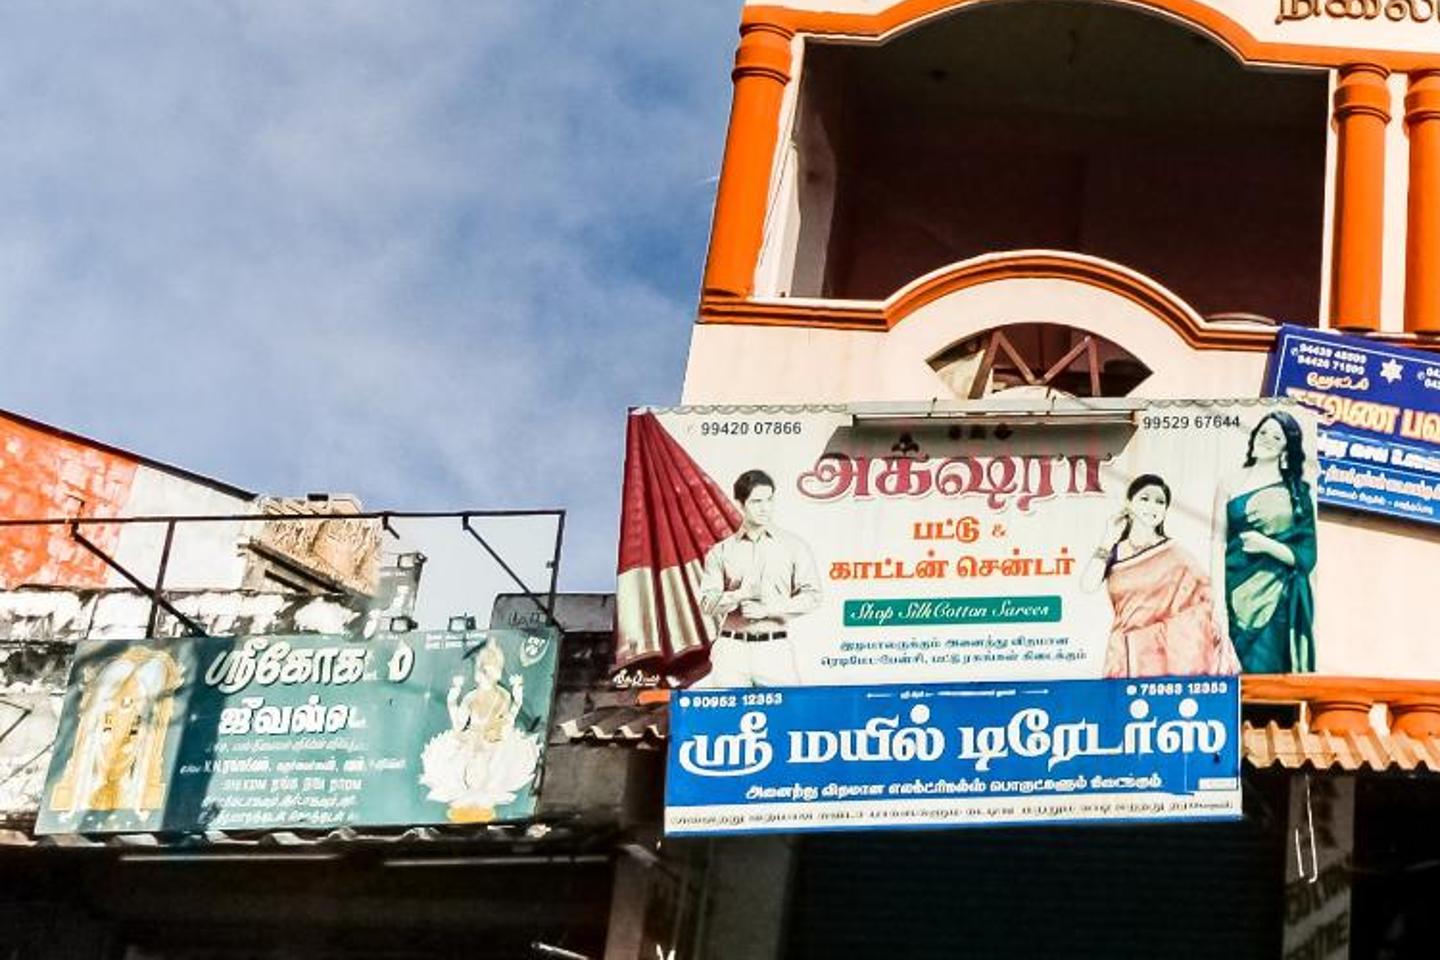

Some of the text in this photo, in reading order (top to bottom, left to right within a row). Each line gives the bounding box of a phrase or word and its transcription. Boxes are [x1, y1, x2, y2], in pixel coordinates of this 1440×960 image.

[701, 422, 801, 435] 99420 07866
[1143, 415, 1240, 429] 99529 67644
[913, 516, 1006, 542] பட்டு &
[829, 546, 1075, 581] காட்டன் சென்டர்
[850, 600, 893, 624] Shop
[992, 599, 1050, 617] Sarees
[679, 698, 1227, 777] ஸ்ரீ மயில் டிரேடர்ஸ்
